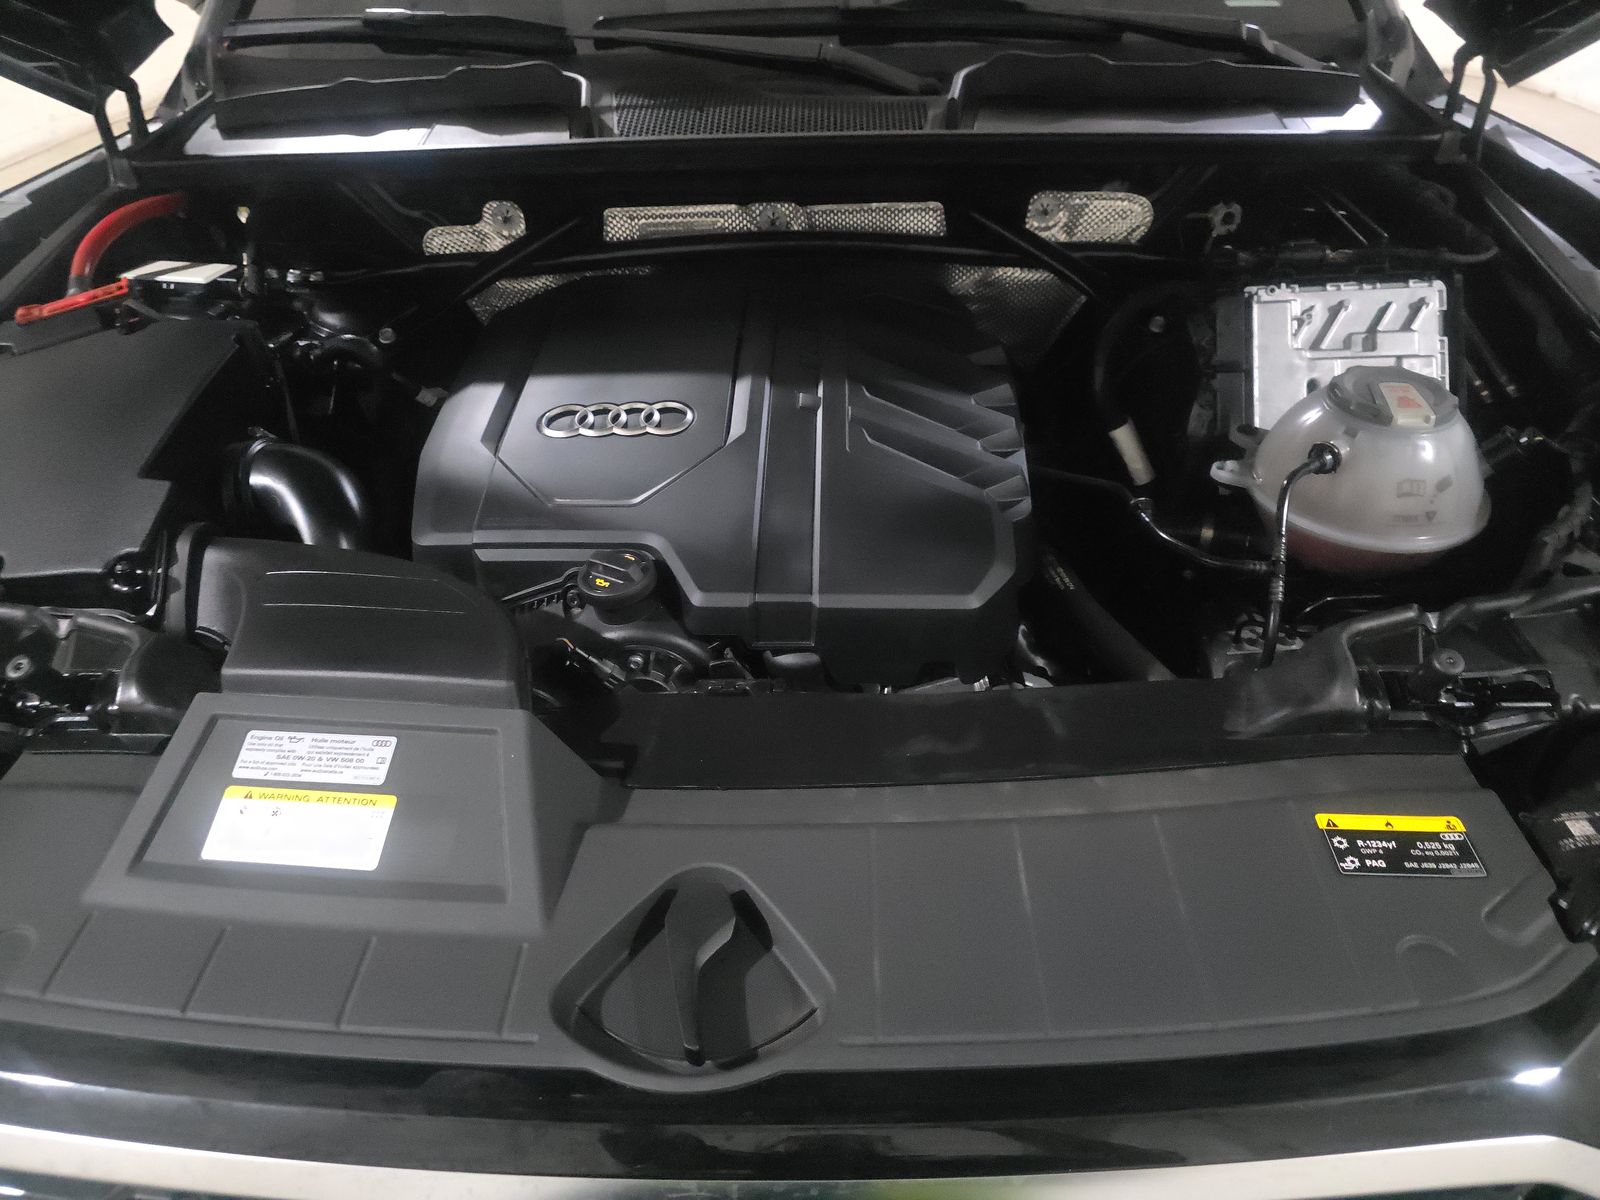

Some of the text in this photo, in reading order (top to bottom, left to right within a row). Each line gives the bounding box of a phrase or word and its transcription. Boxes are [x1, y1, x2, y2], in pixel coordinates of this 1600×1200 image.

[258, 793, 378, 806] WARNING ATTENTION
[1356, 839, 1397, 850] R-1234yf
[1442, 842, 1456, 851] kg
[1365, 859, 1387, 868] PAG
